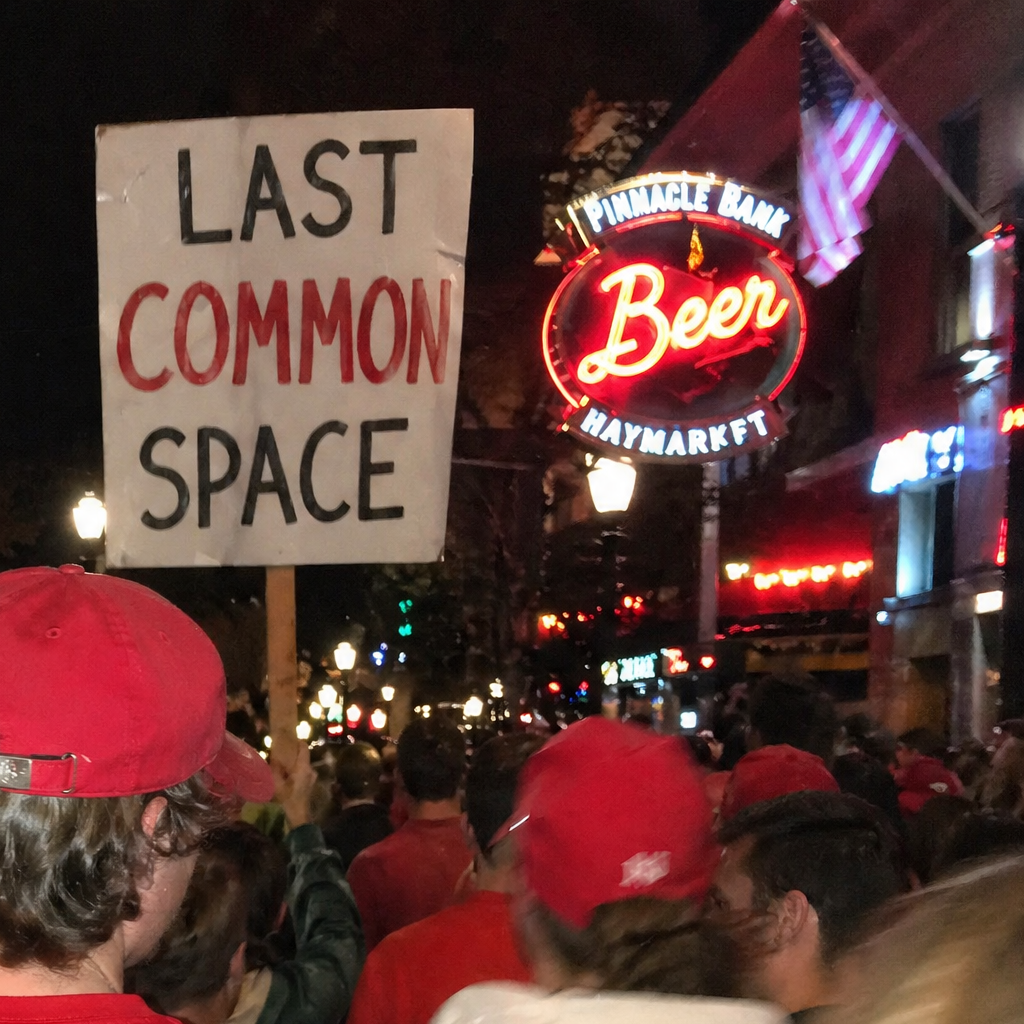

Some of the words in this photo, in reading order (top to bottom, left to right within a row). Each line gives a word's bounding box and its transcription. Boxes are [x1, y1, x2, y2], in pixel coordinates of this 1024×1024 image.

[177, 138, 417, 245] LAST
[116, 276, 453, 392] COMMON
[577, 262, 790, 385] Beer
[139, 417, 409, 531] SPACE
